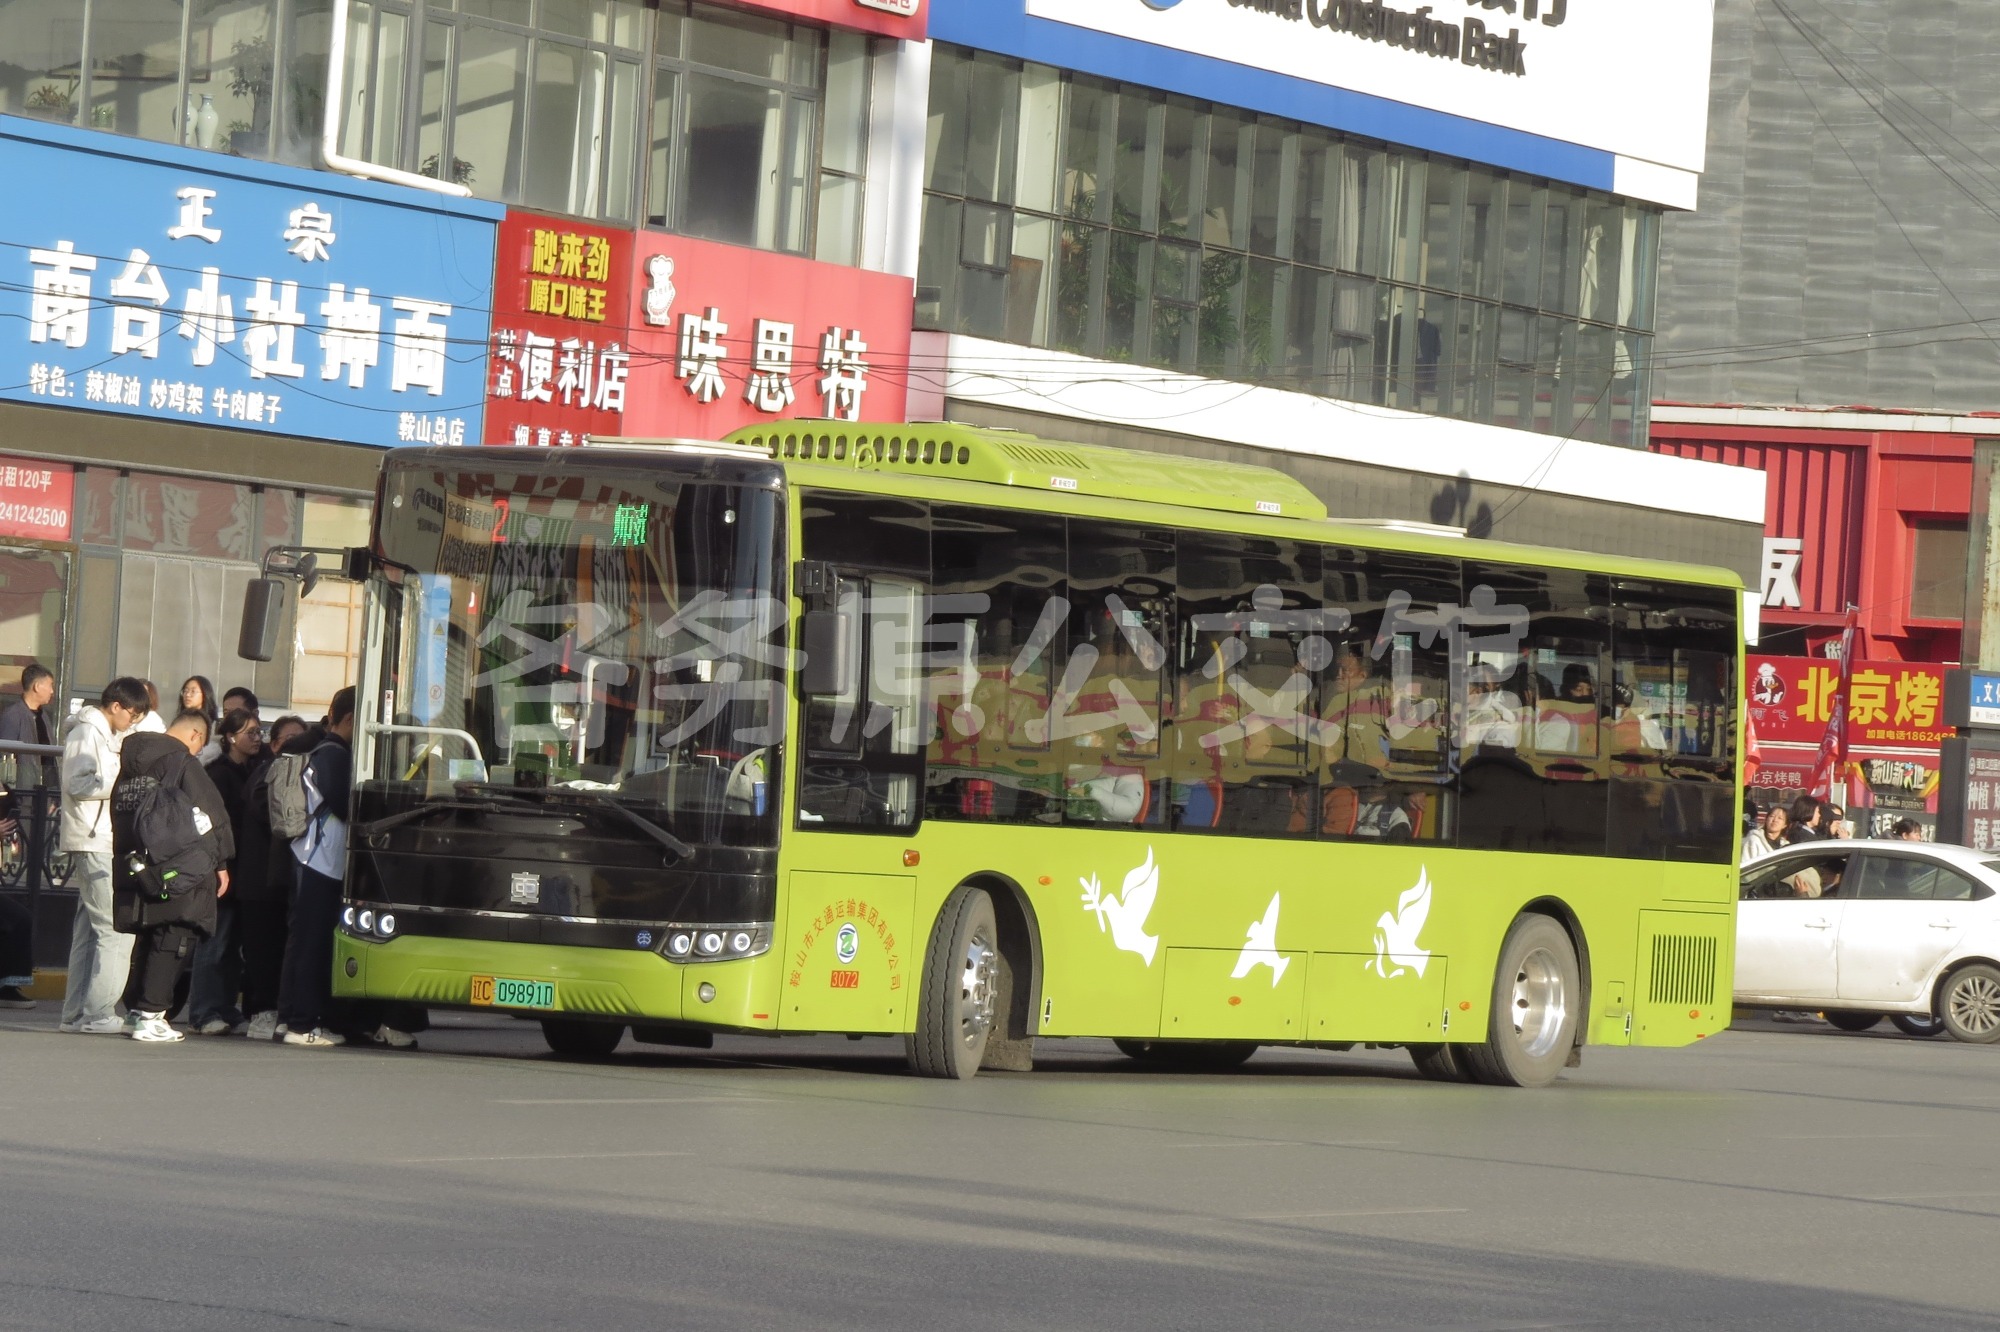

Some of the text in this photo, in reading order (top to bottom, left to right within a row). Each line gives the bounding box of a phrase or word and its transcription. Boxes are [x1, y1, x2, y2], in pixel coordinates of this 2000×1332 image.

[1307, 0, 1460, 61] Construction
[1461, 16, 1527, 77] Bank
[168, 187, 336, 262] 正宗
[532, 229, 610, 282] 秒来劲
[29, 241, 452, 396] 南台小杜抻面
[529, 279, 607, 321] 嚼口味王
[519, 331, 629, 412] 便利店
[678, 307, 869, 421] 味思特
[86, 370, 141, 406] 辣椒油
[150, 379, 203, 415] 炒鸡架
[212, 387, 282, 424] 牛肉腱子
[398, 412, 465, 446] 鞍山总店
[491, 498, 510, 542] 2
[790, 898, 900, 990] 鞍山市交通运输集团有限公司
[831, 971, 858, 987] 3072
